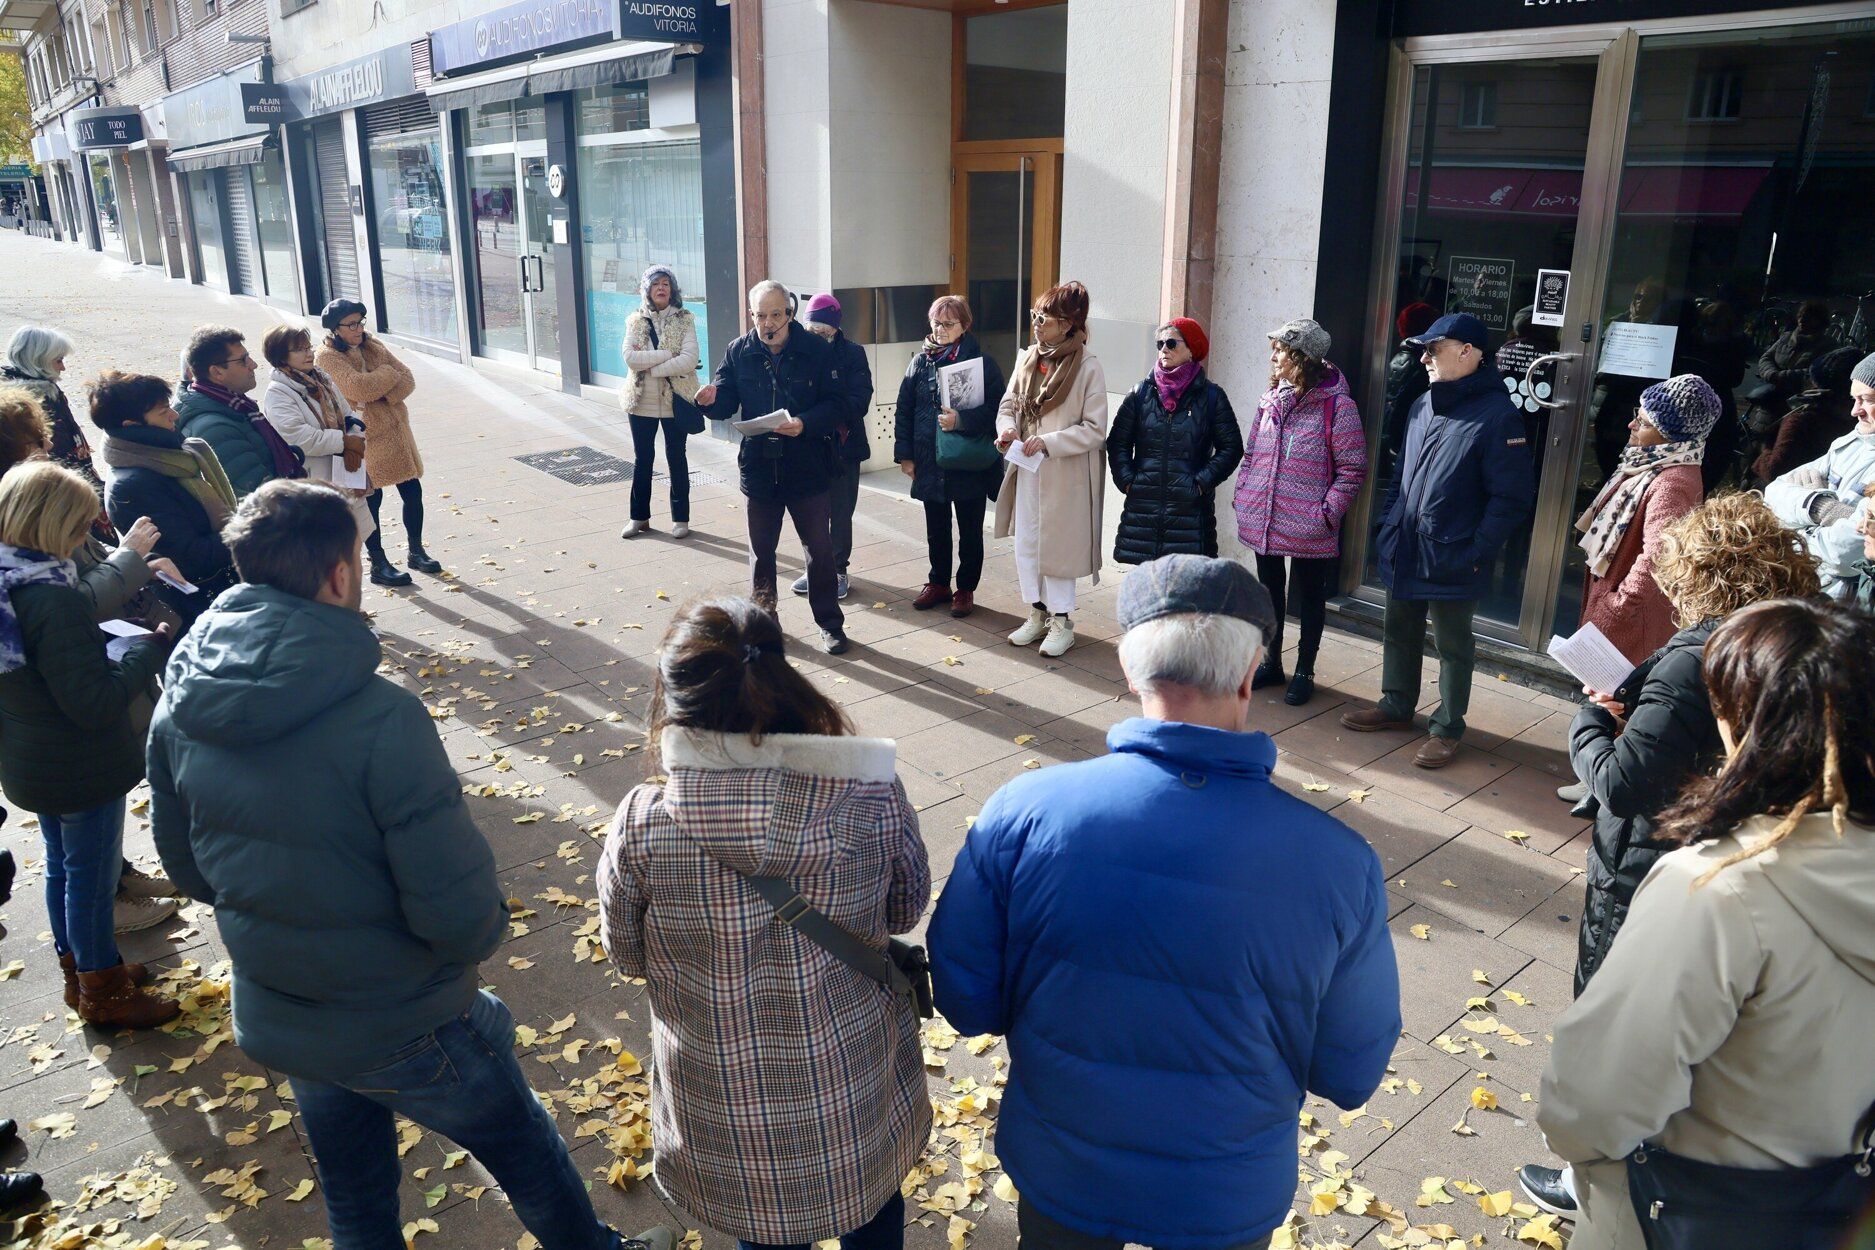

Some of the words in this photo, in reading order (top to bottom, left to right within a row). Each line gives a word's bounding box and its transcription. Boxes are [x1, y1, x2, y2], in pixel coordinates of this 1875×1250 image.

[629, 2, 697, 19] AUDIFONOS
[653, 18, 697, 33] VITORIA
[258, 98, 281, 106] ALAIN
[247, 104, 281, 113] AFFLELOU
[107, 120, 126, 130] TODO
[113, 130, 127, 139] PIEL
[1458, 263, 1507, 276] HORARIO
[1452, 275, 1475, 284] Martes
[1482, 278, 1508, 287] Viernes
[1487, 290, 1509, 299] 18,00
